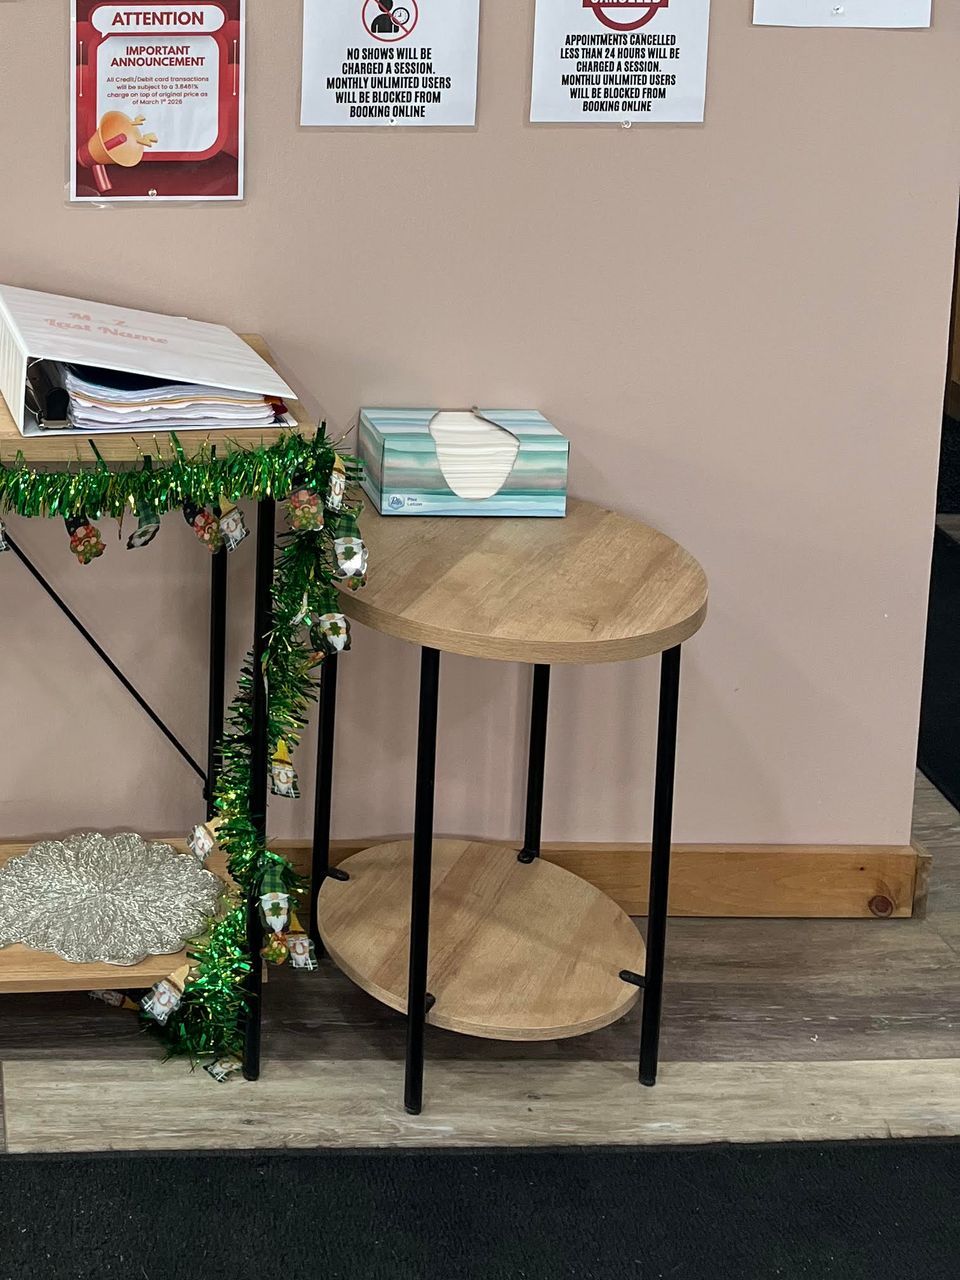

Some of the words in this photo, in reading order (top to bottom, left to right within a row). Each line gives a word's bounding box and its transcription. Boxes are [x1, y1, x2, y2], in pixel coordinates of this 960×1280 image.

[112, 12, 204, 25] ATTENTION
[565, 34, 627, 46] APPOINTMENTS
[630, 34, 676, 45] CANCELLED
[126, 46, 190, 55] IMPORTANT
[347, 48, 359, 60] NO
[362, 48, 394, 60] SHOWS
[396, 48, 418, 60] WILL
[421, 48, 432, 59] BE
[560, 48, 579, 59] LESS
[581, 48, 602, 59] THAN
[605, 48, 615, 59] 24
[618, 48, 645, 59] HOURS
[648, 48, 667, 59] WILL
[670, 48, 680, 59] BE
[111, 57, 205, 67] ANNOUNCEMENT
[576, 61, 614, 72] CHARGED
[616, 62, 622, 72] A
[624, 61, 661, 72] SESSION.
[342, 62, 383, 74] CHARGED
[386, 62, 392, 74] A
[394, 62, 435, 74] SESSION.
[327, 77, 368, 89] MONTHLY
[371, 77, 419, 88] UNLIMITED
[422, 77, 451, 88] USERS
[562, 74, 600, 85] MONTHLU
[603, 74, 646, 85] UNLIMITED
[650, 74, 676, 85] USERS
[336, 92, 356, 103] WILL
[359, 92, 370, 103] BE
[372, 92, 411, 103] BLOCKED
[415, 91, 441, 103] FROM
[570, 88, 589, 98] WILL
[592, 88, 601, 98] BE
[604, 88, 640, 98] BLOCKED
[642, 88, 666, 98] FROM
[350, 106, 390, 117] BOOKING
[393, 106, 425, 117] ONLINE
[583, 101, 619, 112] BOOKING
[622, 101, 651, 112] ONLINE
[43, 318, 91, 332] Last
[98, 326, 169, 345] Name
